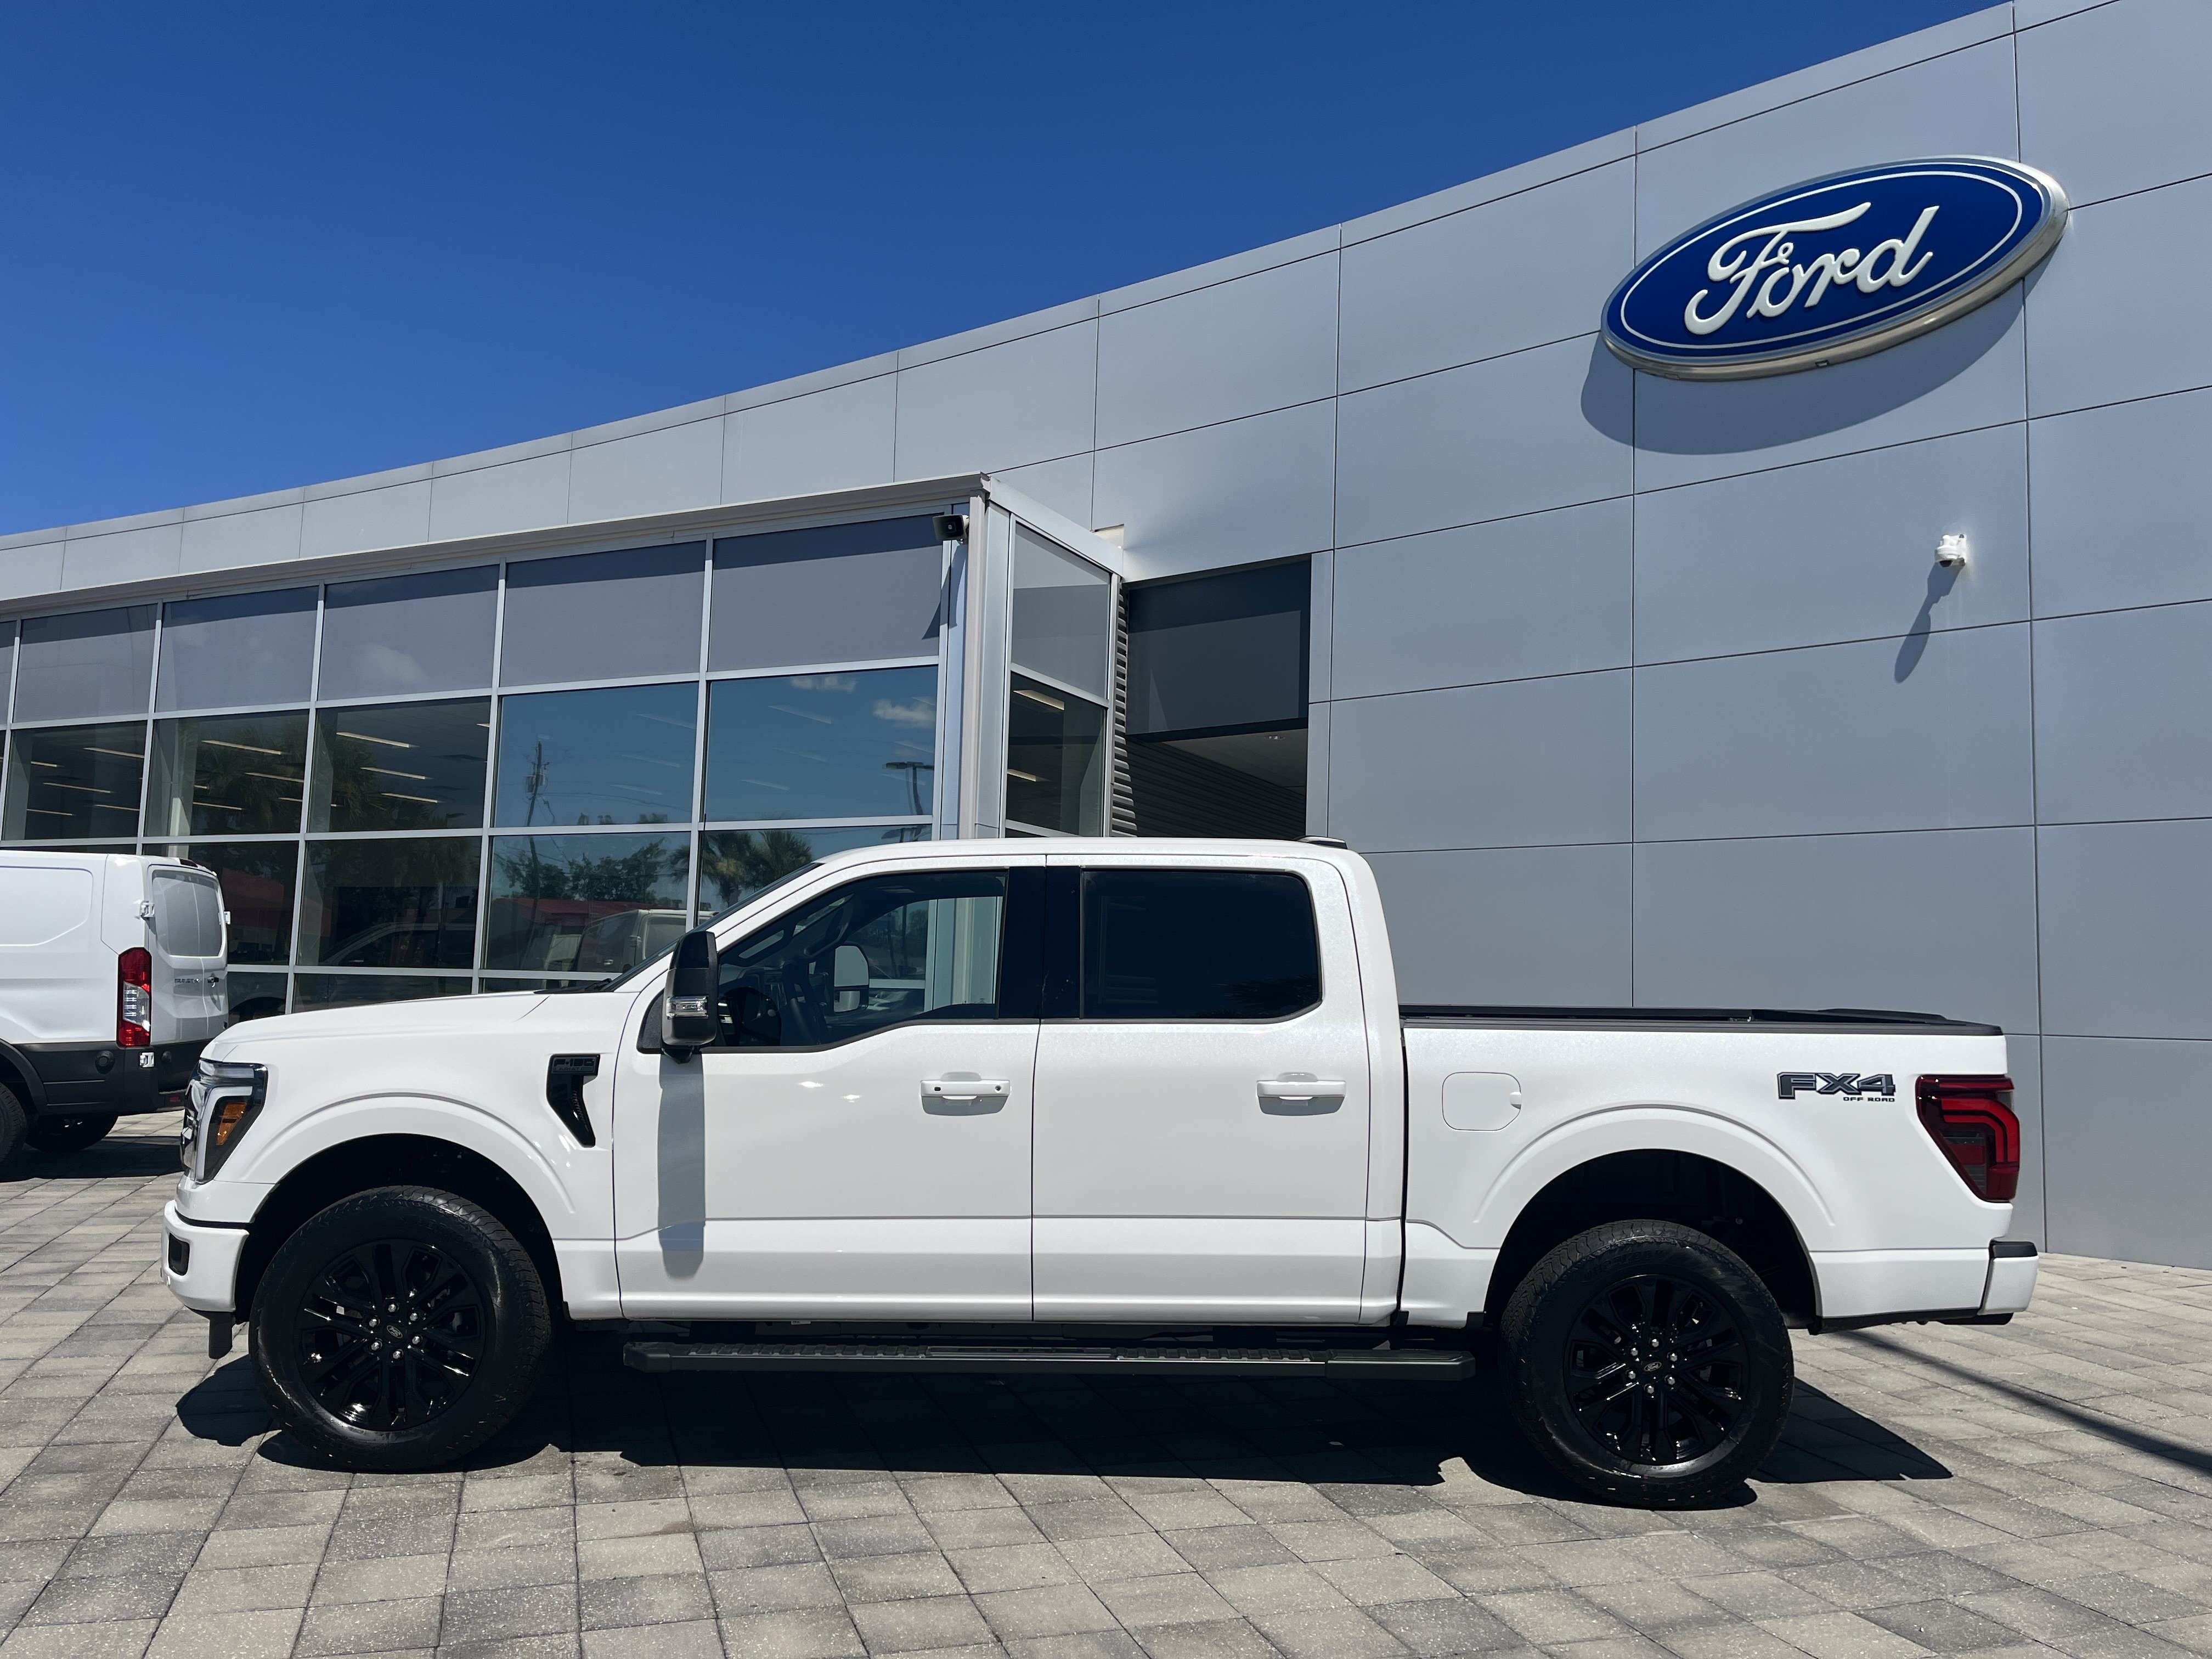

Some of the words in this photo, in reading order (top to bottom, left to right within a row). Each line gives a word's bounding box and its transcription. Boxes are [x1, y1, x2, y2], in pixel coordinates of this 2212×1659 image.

[1684, 201, 1940, 335] Ford
[554, 1058, 595, 1067] F-150
[1776, 1071, 1896, 1100] FX4
